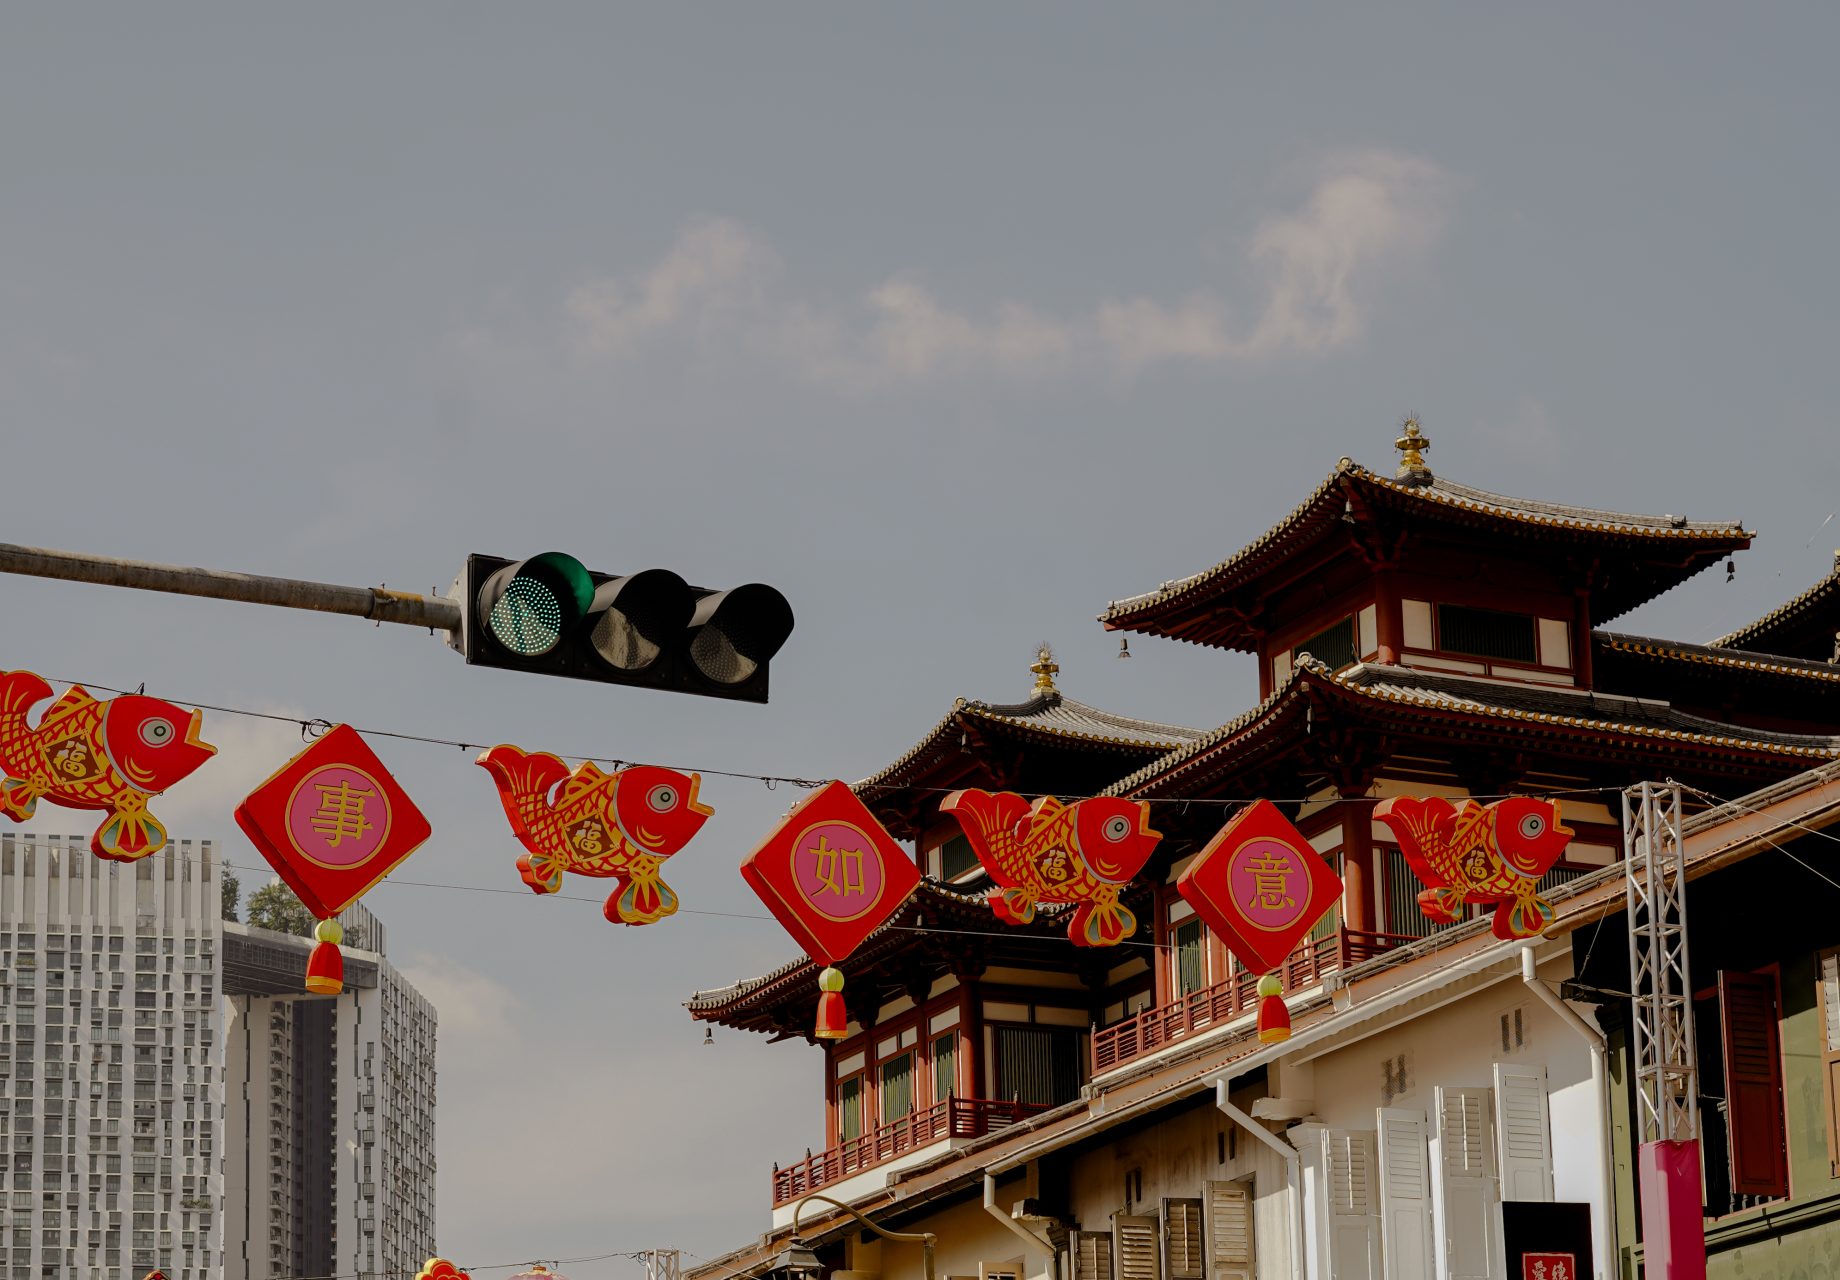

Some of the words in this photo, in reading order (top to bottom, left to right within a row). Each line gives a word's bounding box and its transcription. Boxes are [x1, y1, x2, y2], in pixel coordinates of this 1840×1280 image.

[53, 740, 87, 777] 福
[310, 780, 376, 848] 事
[575, 820, 602, 854] 福
[808, 835, 864, 897] 如
[1040, 849, 1068, 880] 福
[1244, 851, 1295, 910] 意
[1465, 849, 1488, 879] 福
